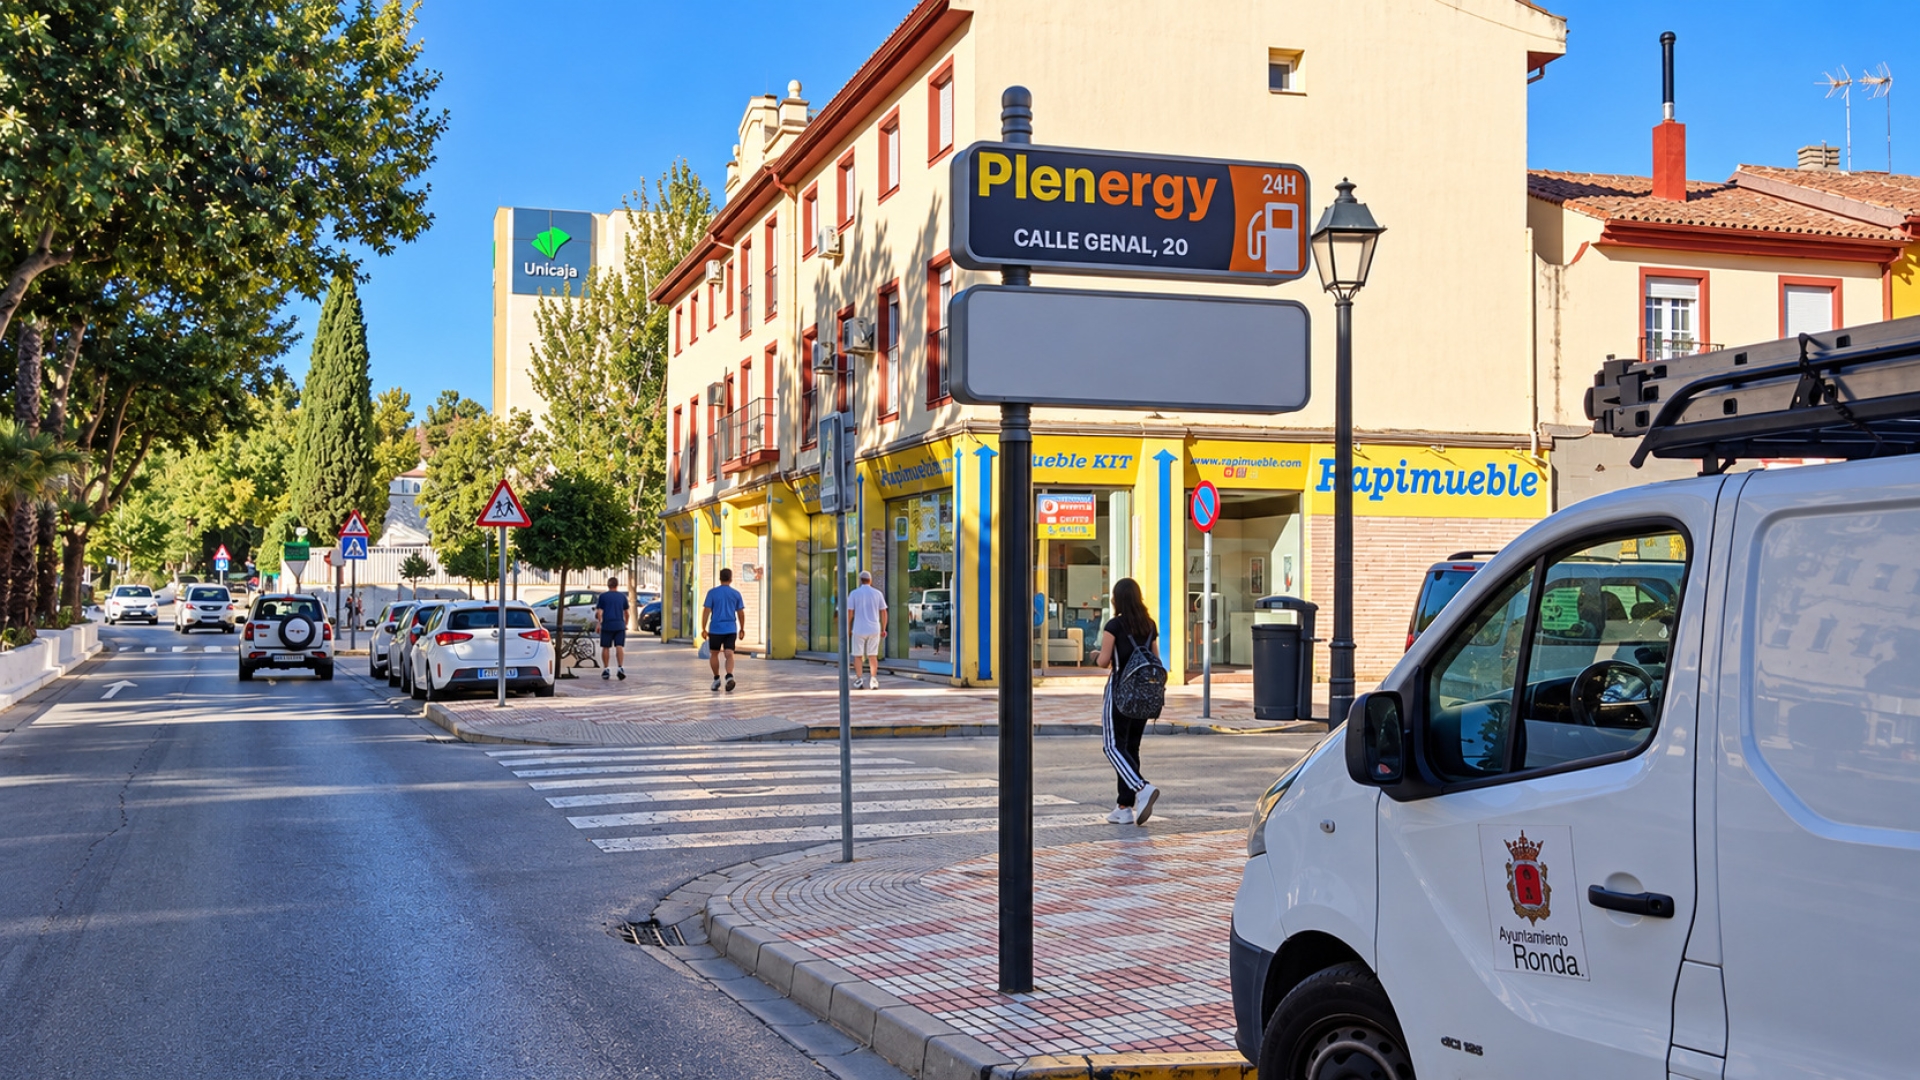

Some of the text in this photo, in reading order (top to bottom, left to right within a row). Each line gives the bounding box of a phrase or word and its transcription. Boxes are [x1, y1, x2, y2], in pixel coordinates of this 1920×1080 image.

[978, 151, 1218, 222] Plenergy
[1262, 173, 1297, 196] 24H
[1013, 228, 1189, 258] CALLE GENAL, 20
[524, 261, 578, 280] Unicaja
[1031, 452, 1133, 469] ueble KIT
[1190, 456, 1302, 468] www.rapimueble.com
[1499, 926, 1569, 947] Ayuntamiento
[1513, 943, 1585, 978] Ronda.
